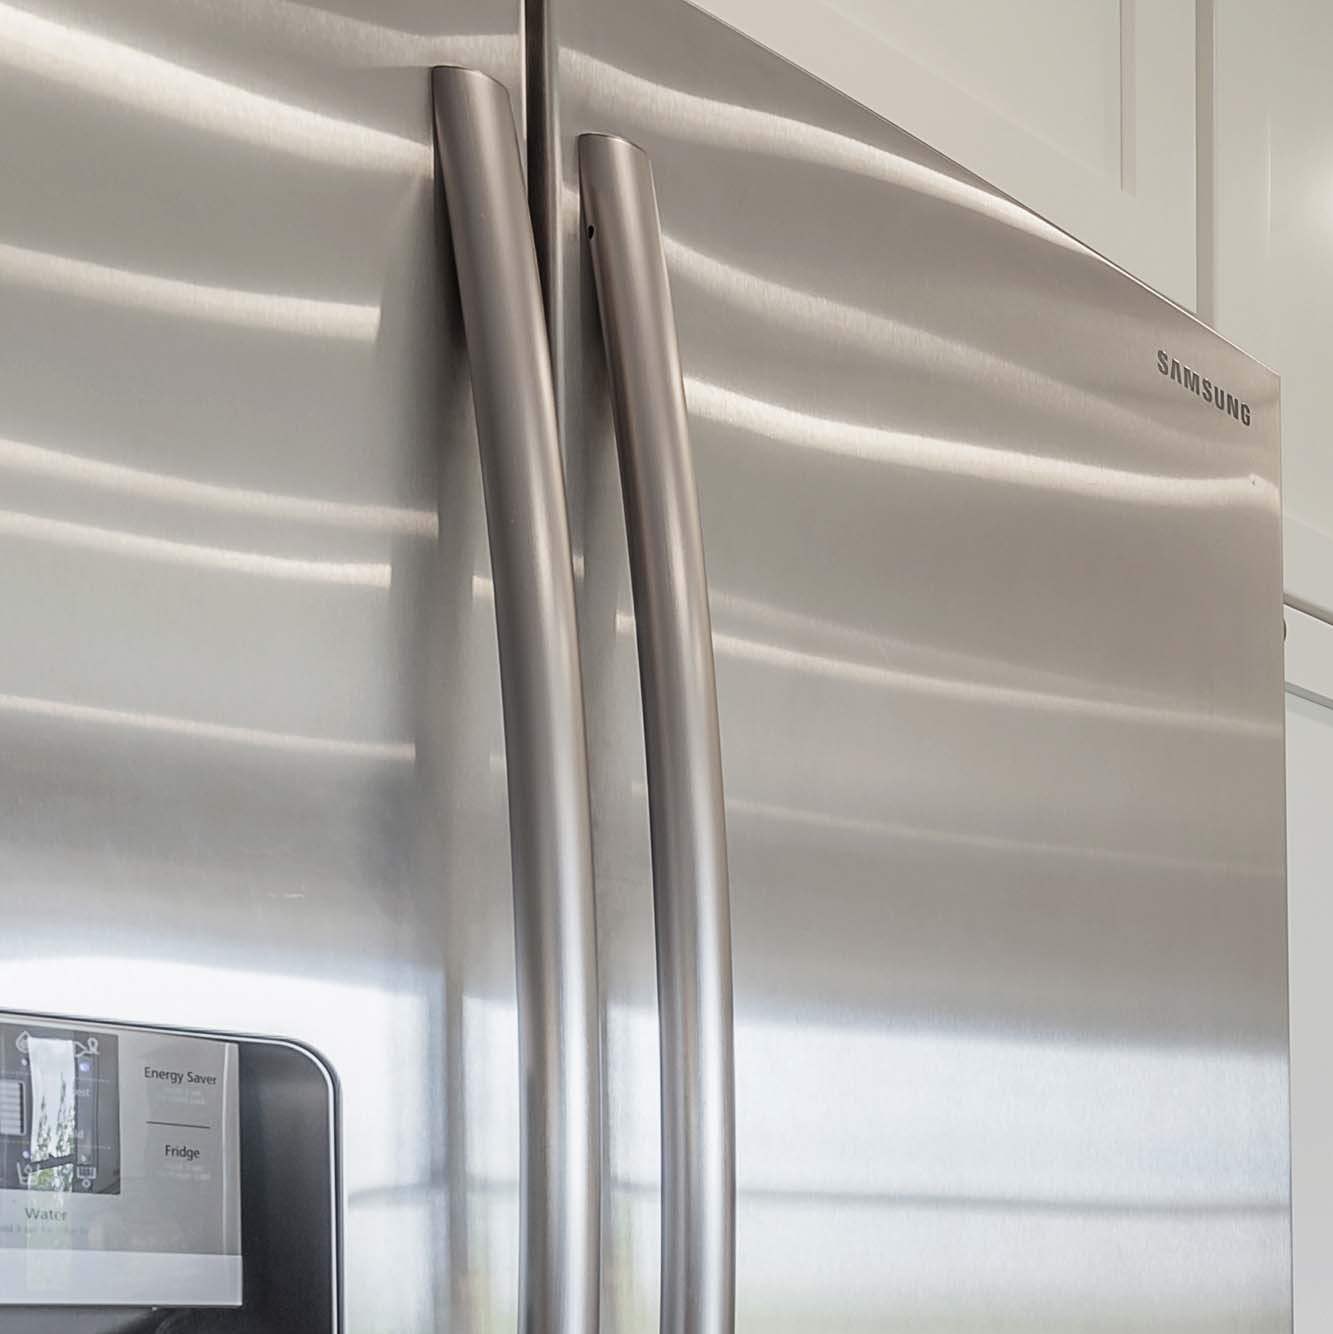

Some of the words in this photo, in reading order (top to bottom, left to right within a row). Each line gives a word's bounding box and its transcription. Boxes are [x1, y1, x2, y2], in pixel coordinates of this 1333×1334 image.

[1156, 349, 1252, 427] SAMSUNG
[143, 1066, 184, 1085] Energy
[187, 1071, 217, 1086] Saver
[164, 1143, 201, 1162] Fridge
[25, 1206, 68, 1222] Water
